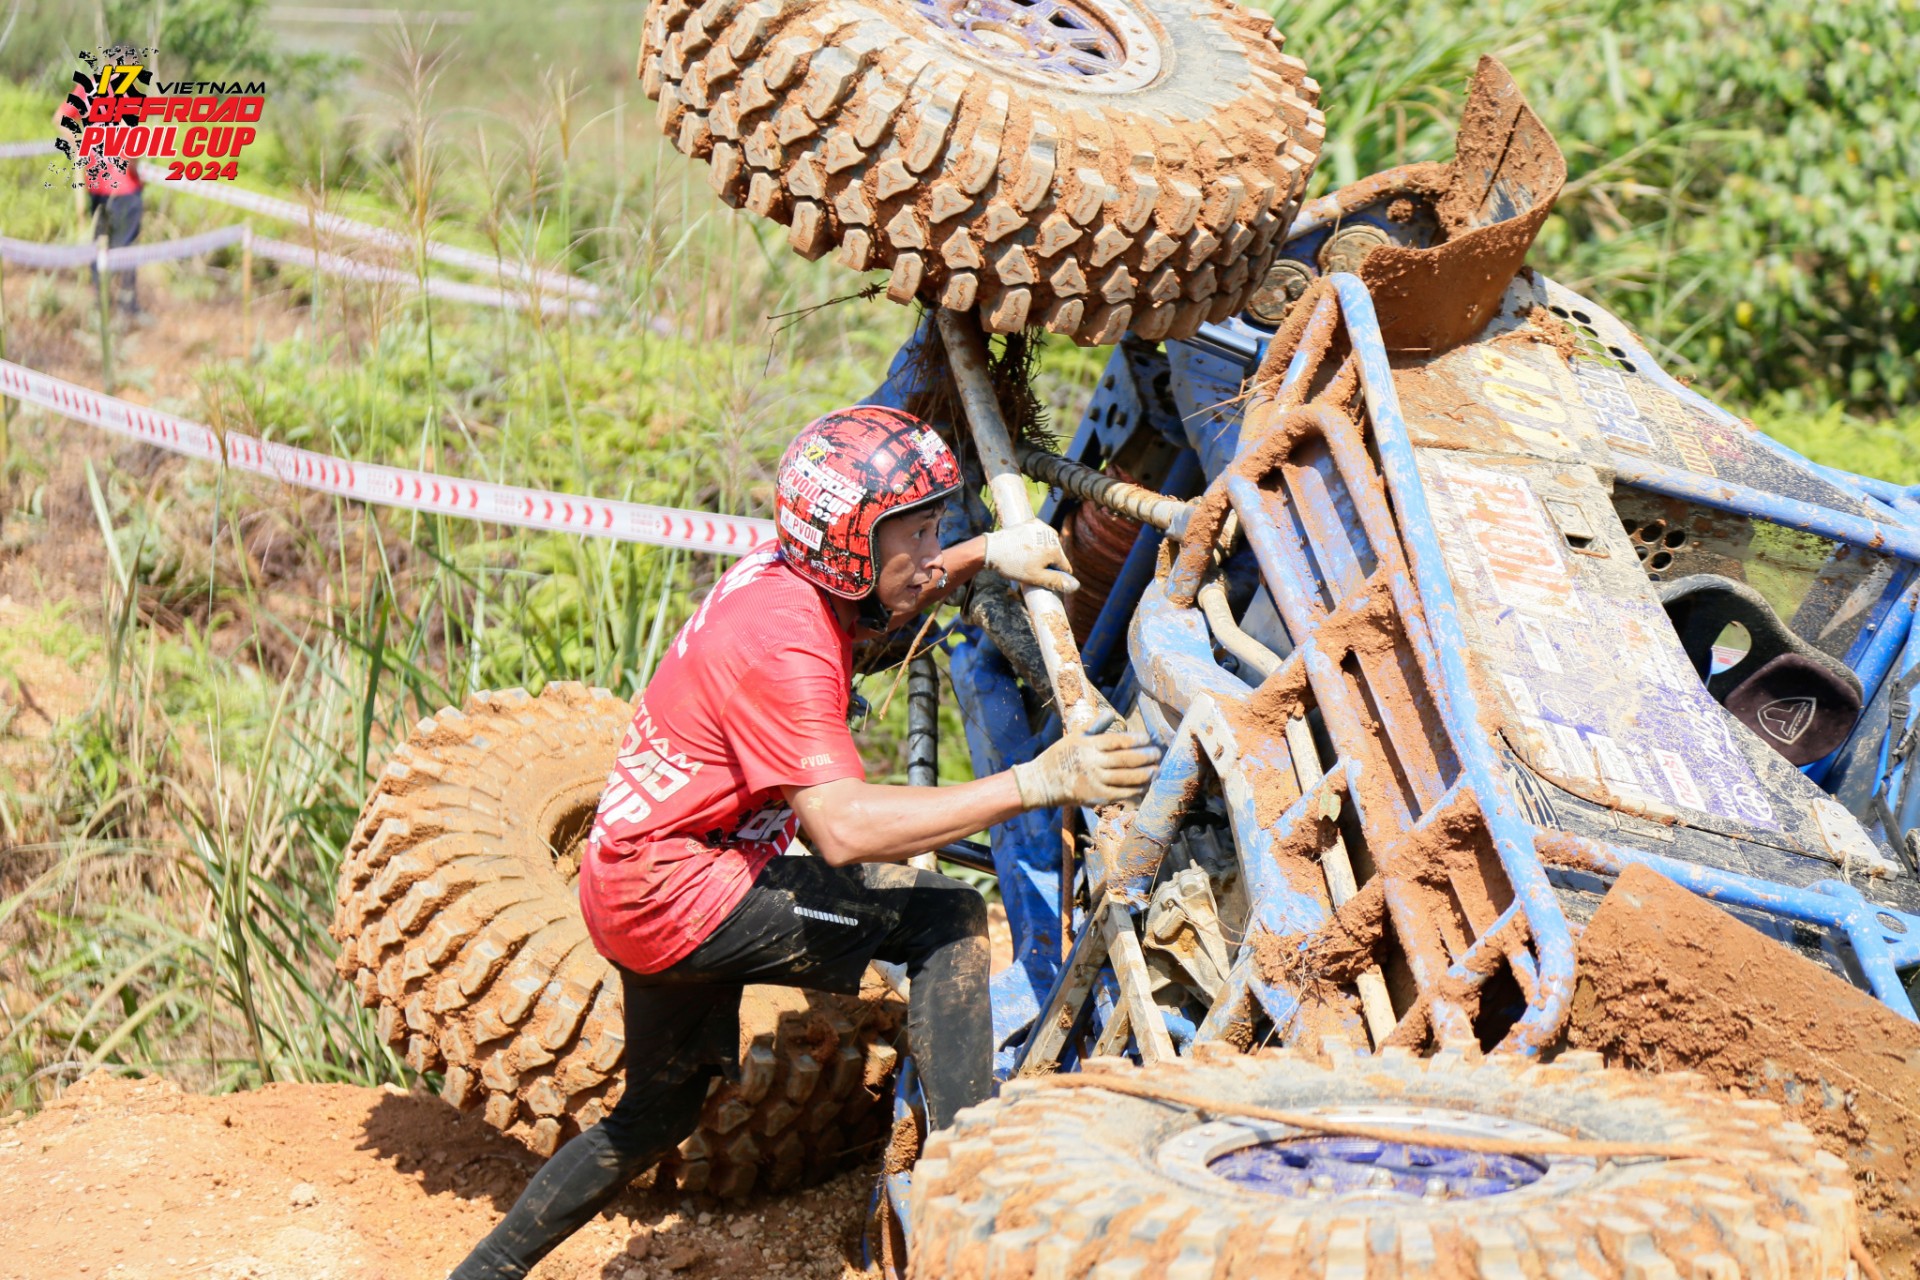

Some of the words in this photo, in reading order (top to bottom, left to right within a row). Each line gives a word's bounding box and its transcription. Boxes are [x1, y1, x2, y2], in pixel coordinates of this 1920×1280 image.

[785, 467, 822, 501] PVOIL
[815, 490, 853, 518] CUP
[793, 455, 864, 506] OFFROAD
[820, 463, 868, 495] VIETNAM
[791, 517, 820, 544] PVOIL
[805, 503, 839, 526] 2024
[1680, 699, 1740, 770] Ford
[800, 753, 834, 770] PVOIL
[1663, 754, 1698, 804] ISUZU
[1706, 772, 1741, 818] TOYOTA
